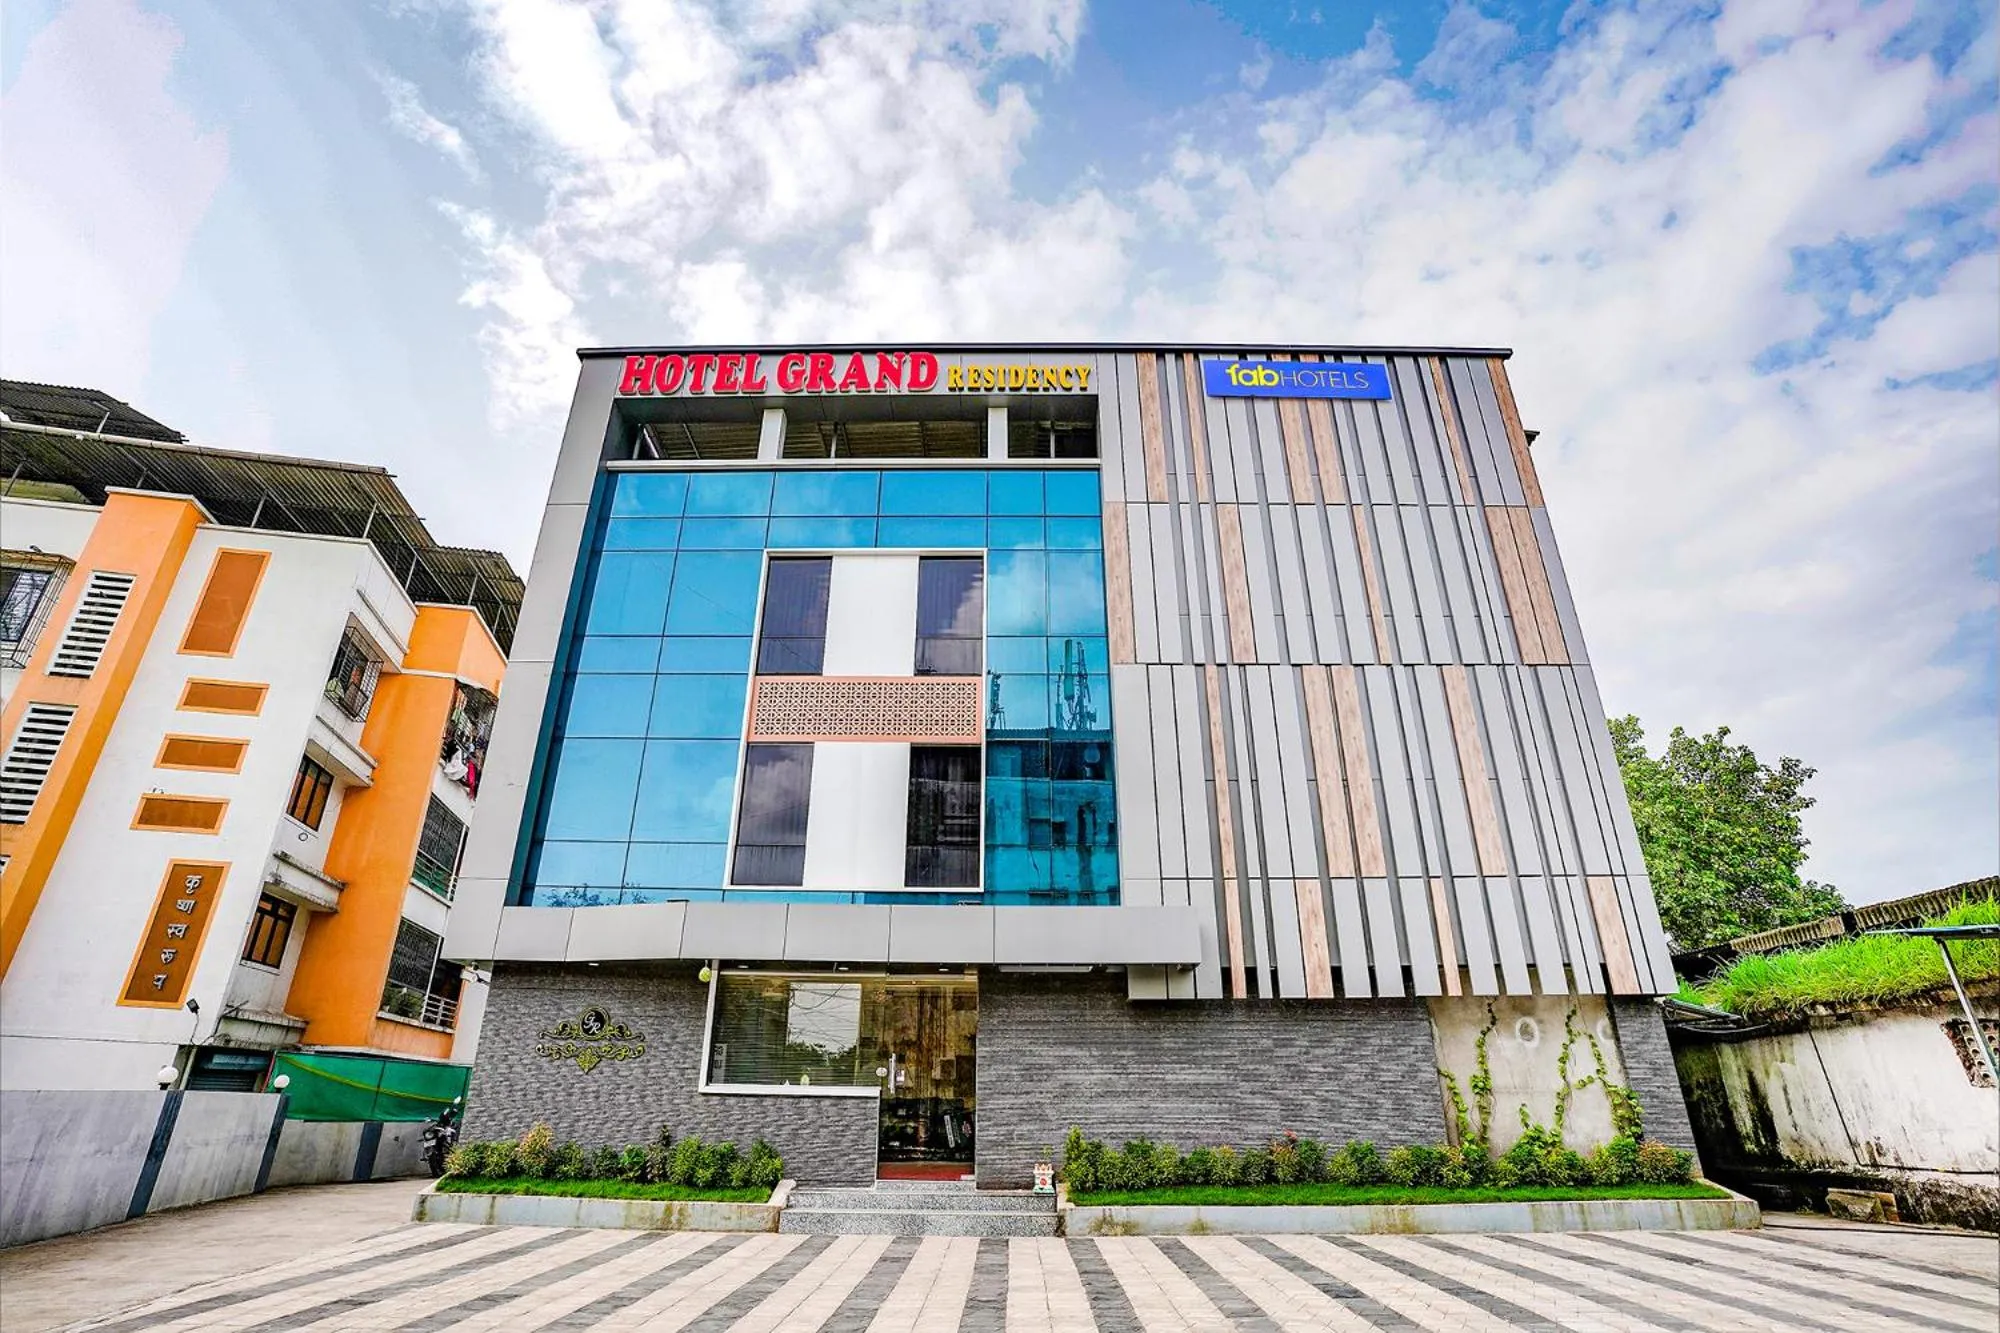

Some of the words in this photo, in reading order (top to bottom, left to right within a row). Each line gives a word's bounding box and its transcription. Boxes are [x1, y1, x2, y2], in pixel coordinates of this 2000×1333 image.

[618, 354, 768, 395] HOTEL
[775, 351, 940, 394] GRAND
[946, 364, 1092, 393] RESIDENCY
